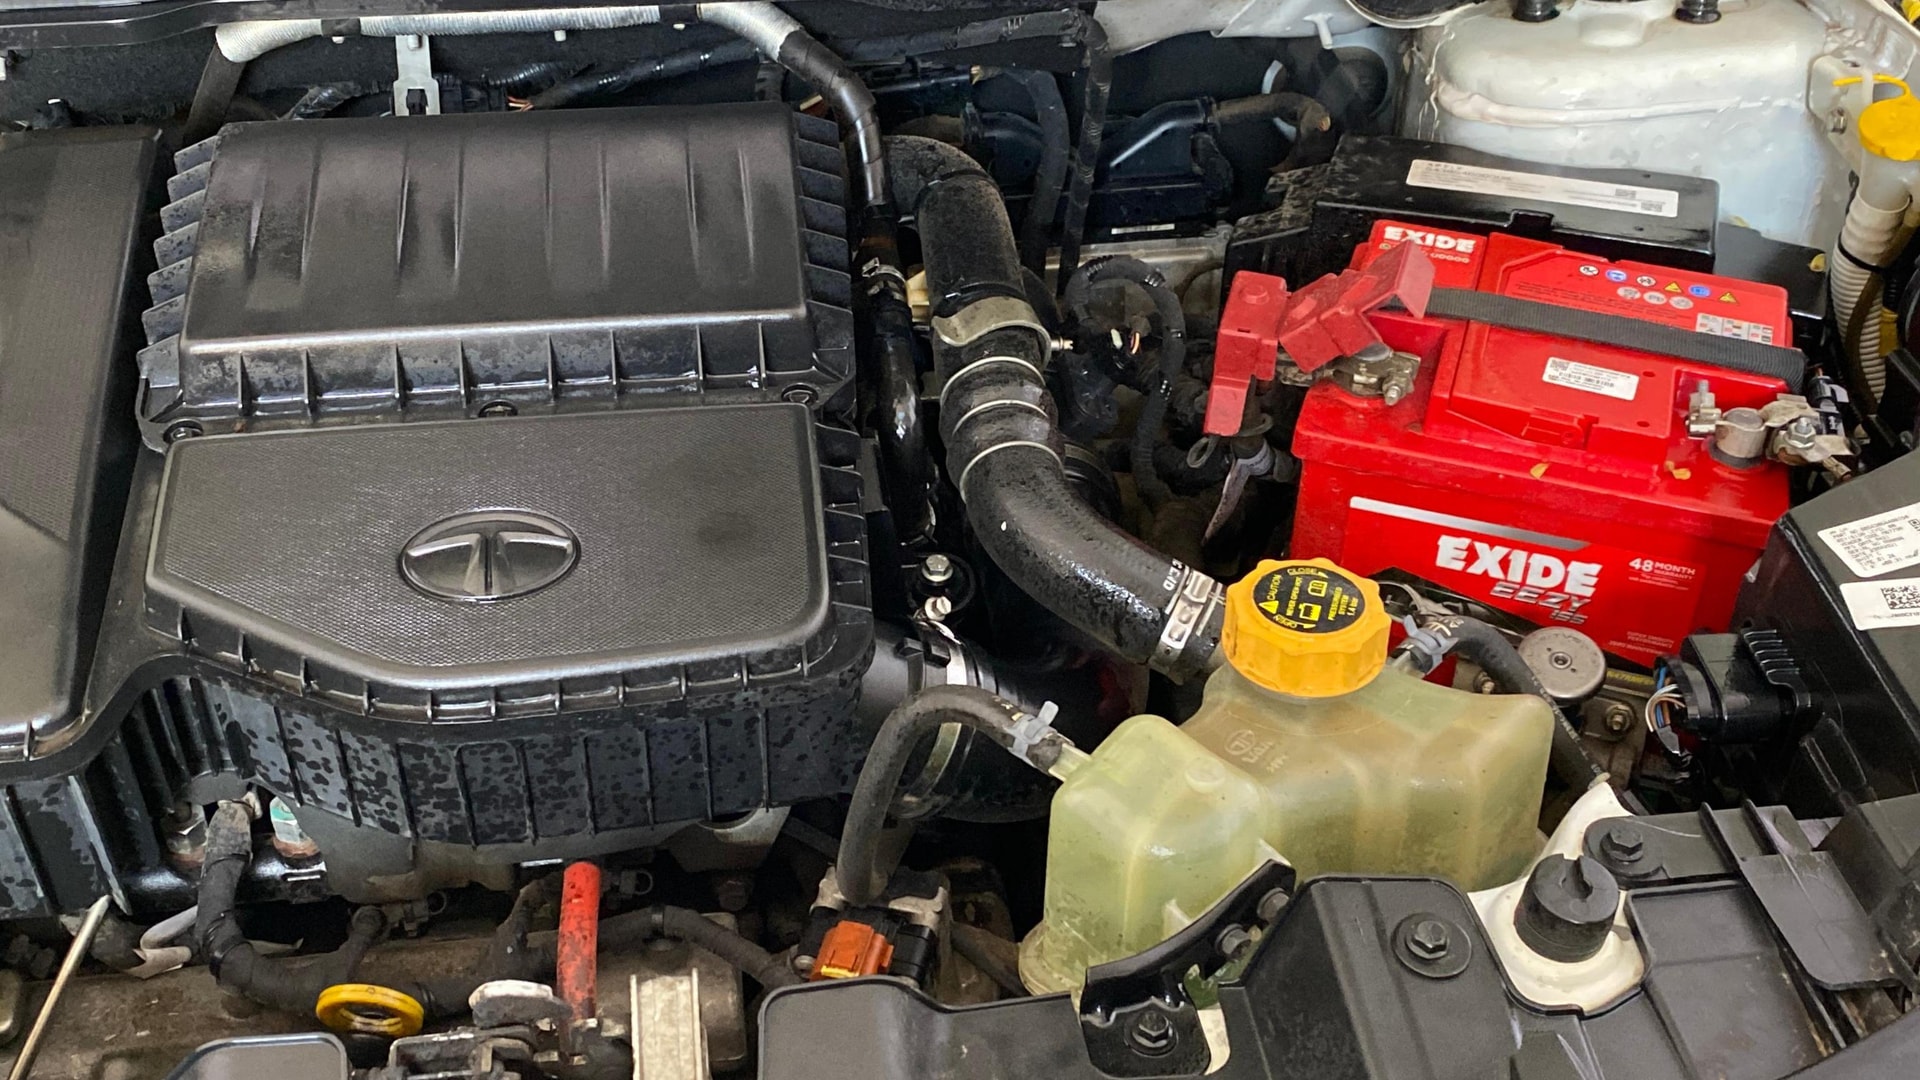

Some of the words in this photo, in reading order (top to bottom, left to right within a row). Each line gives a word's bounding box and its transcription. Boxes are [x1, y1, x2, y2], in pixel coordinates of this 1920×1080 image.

[1384, 226, 1476, 253] EXIDE
[1286, 567, 1319, 576] CLOSE
[1435, 534, 1603, 597] EXIDE
[1628, 557, 1654, 572] 48
[1654, 561, 1696, 575] MONTH
[1267, 574, 1282, 600] CAUTION
[1490, 581, 1591, 612] EEZY
[1346, 606, 1357, 616] 1.4
